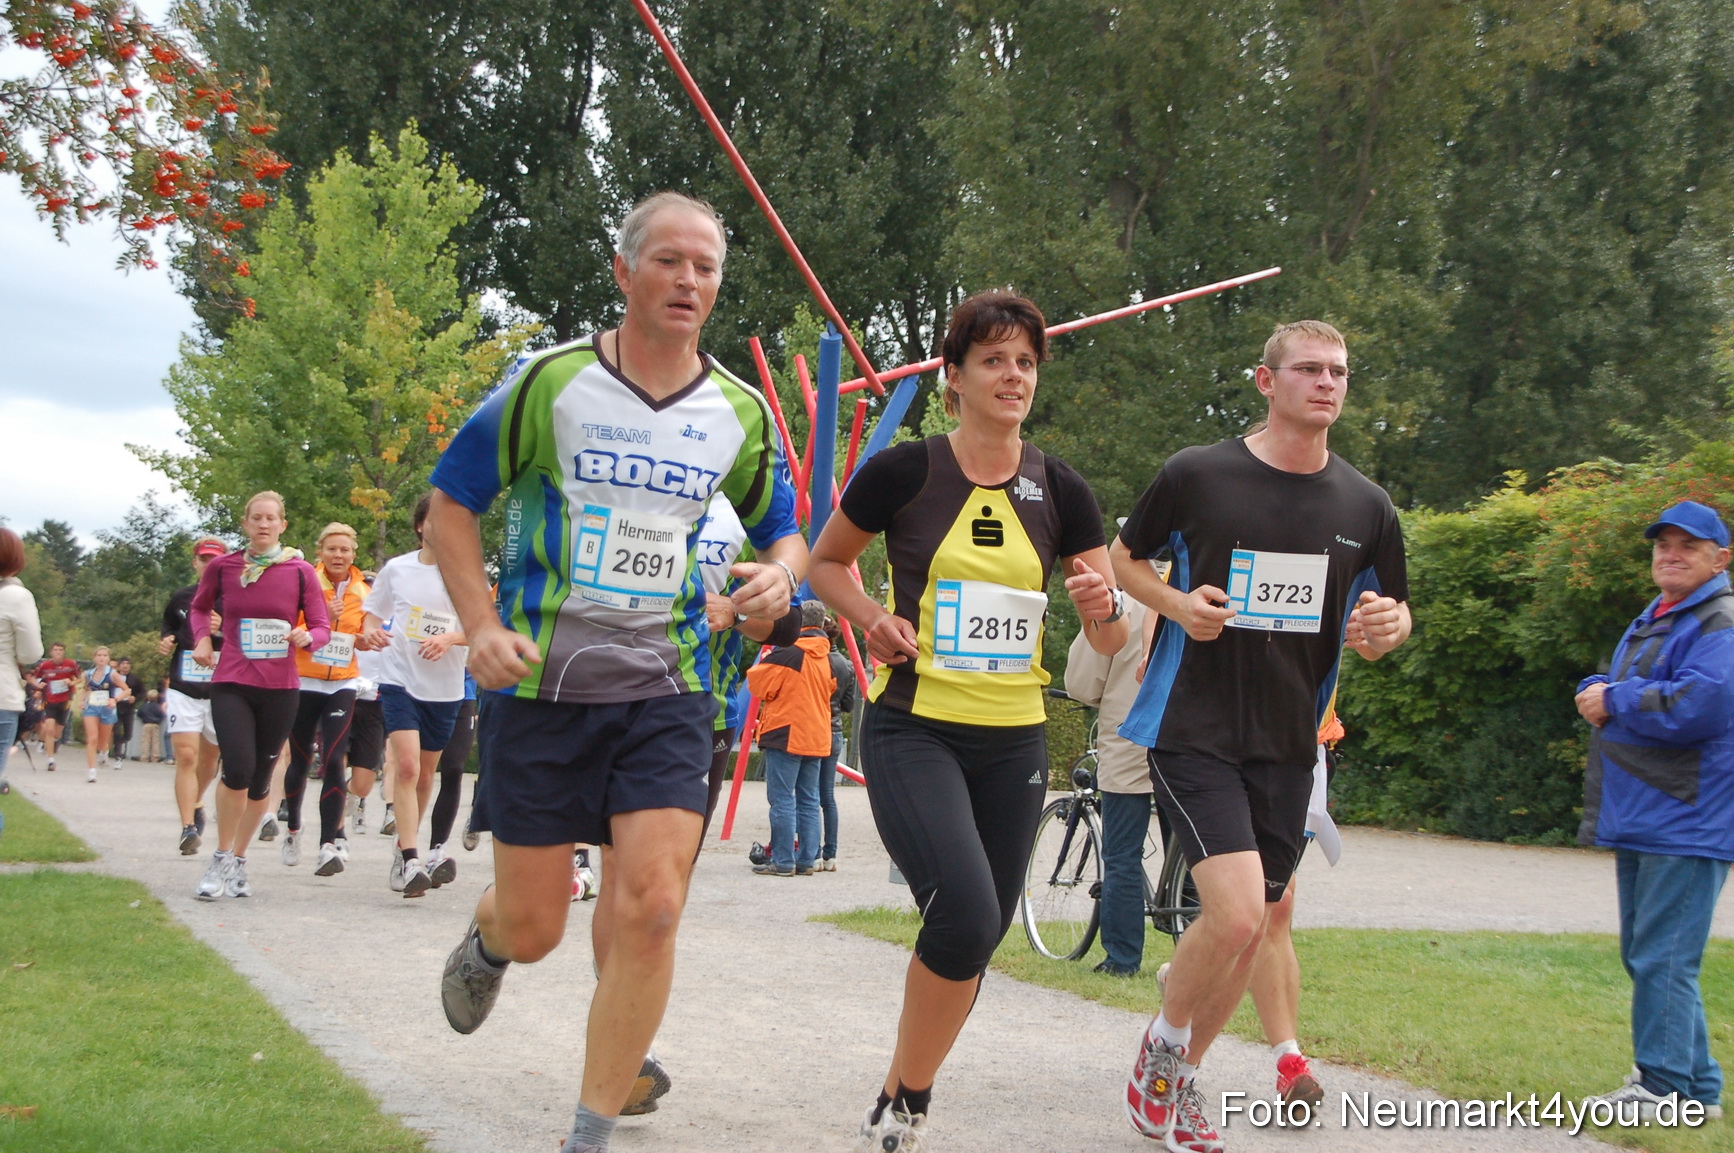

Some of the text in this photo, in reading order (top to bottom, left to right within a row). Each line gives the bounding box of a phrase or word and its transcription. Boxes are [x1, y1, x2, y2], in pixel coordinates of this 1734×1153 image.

[582, 423, 651, 445] TEAM
[574, 449, 721, 502] BOCK
[617, 518, 673, 543] Hermann
[586, 541, 594, 554] B
[612, 548, 675, 579] 2691
[1257, 582, 1313, 604] 3723
[968, 616, 1028, 641] 2815
[1284, 619, 1318, 627] PFLEIDERER
[256, 633, 286, 645] 3082
[327, 644, 350, 656] 3189
[170, 714, 177, 728] 9
